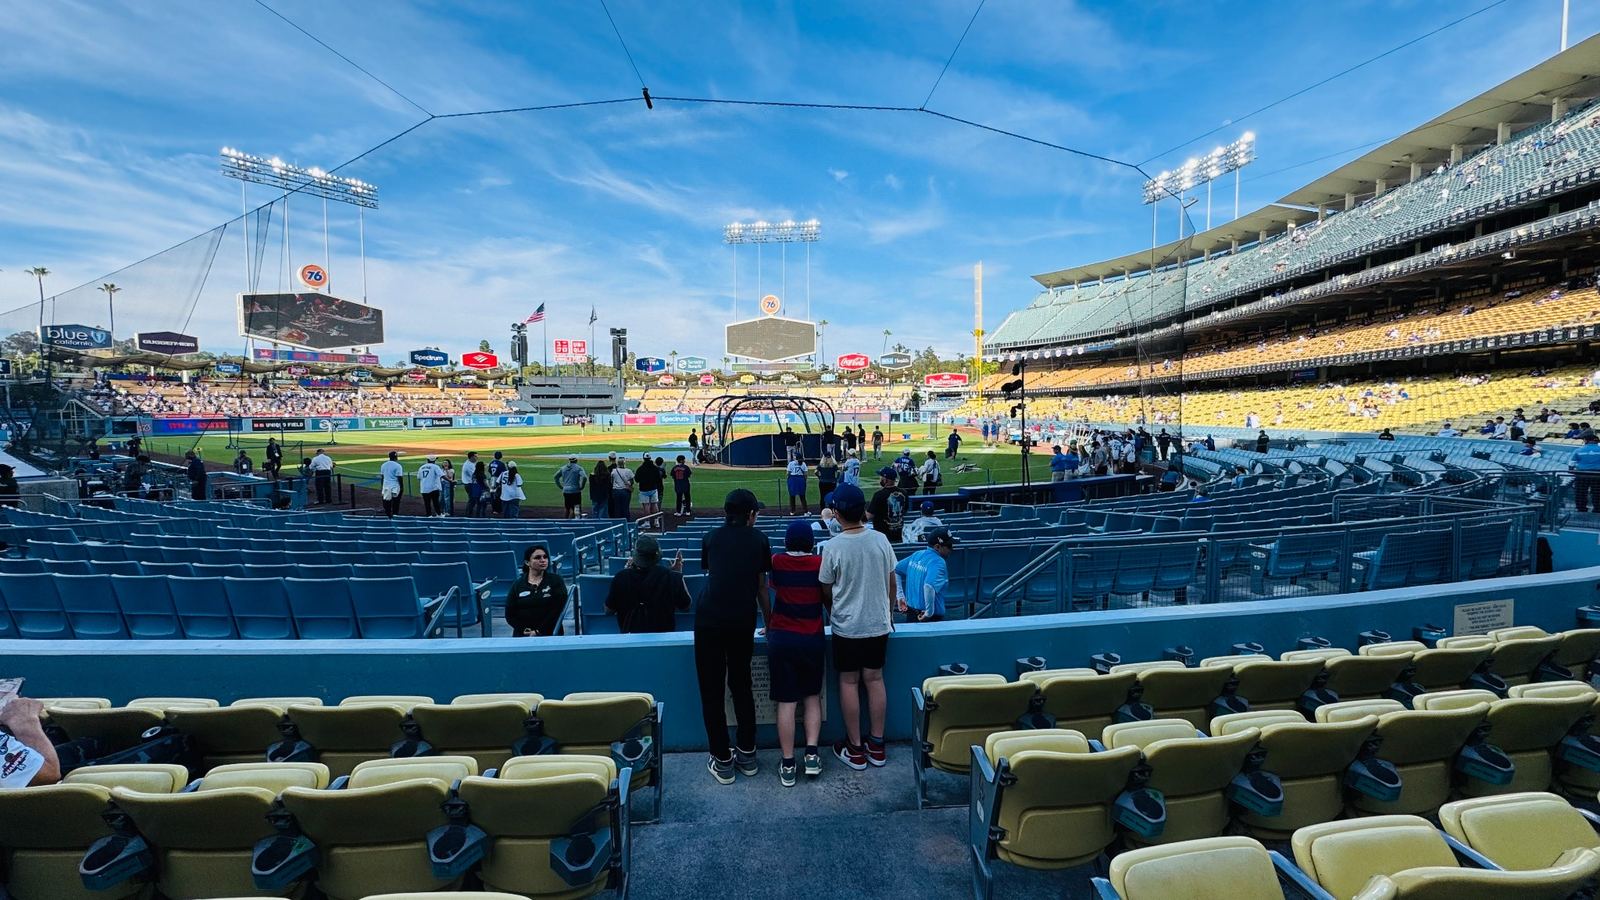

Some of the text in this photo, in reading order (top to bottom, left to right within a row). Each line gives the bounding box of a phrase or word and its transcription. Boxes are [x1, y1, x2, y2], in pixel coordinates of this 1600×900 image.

[307, 271, 322, 281] 76
[766, 301, 776, 309] 76
[47, 327, 88, 341] blue
[414, 354, 443, 362] Spectrum
[459, 418, 476, 426] TEL
[422, 470, 430, 479] 17
